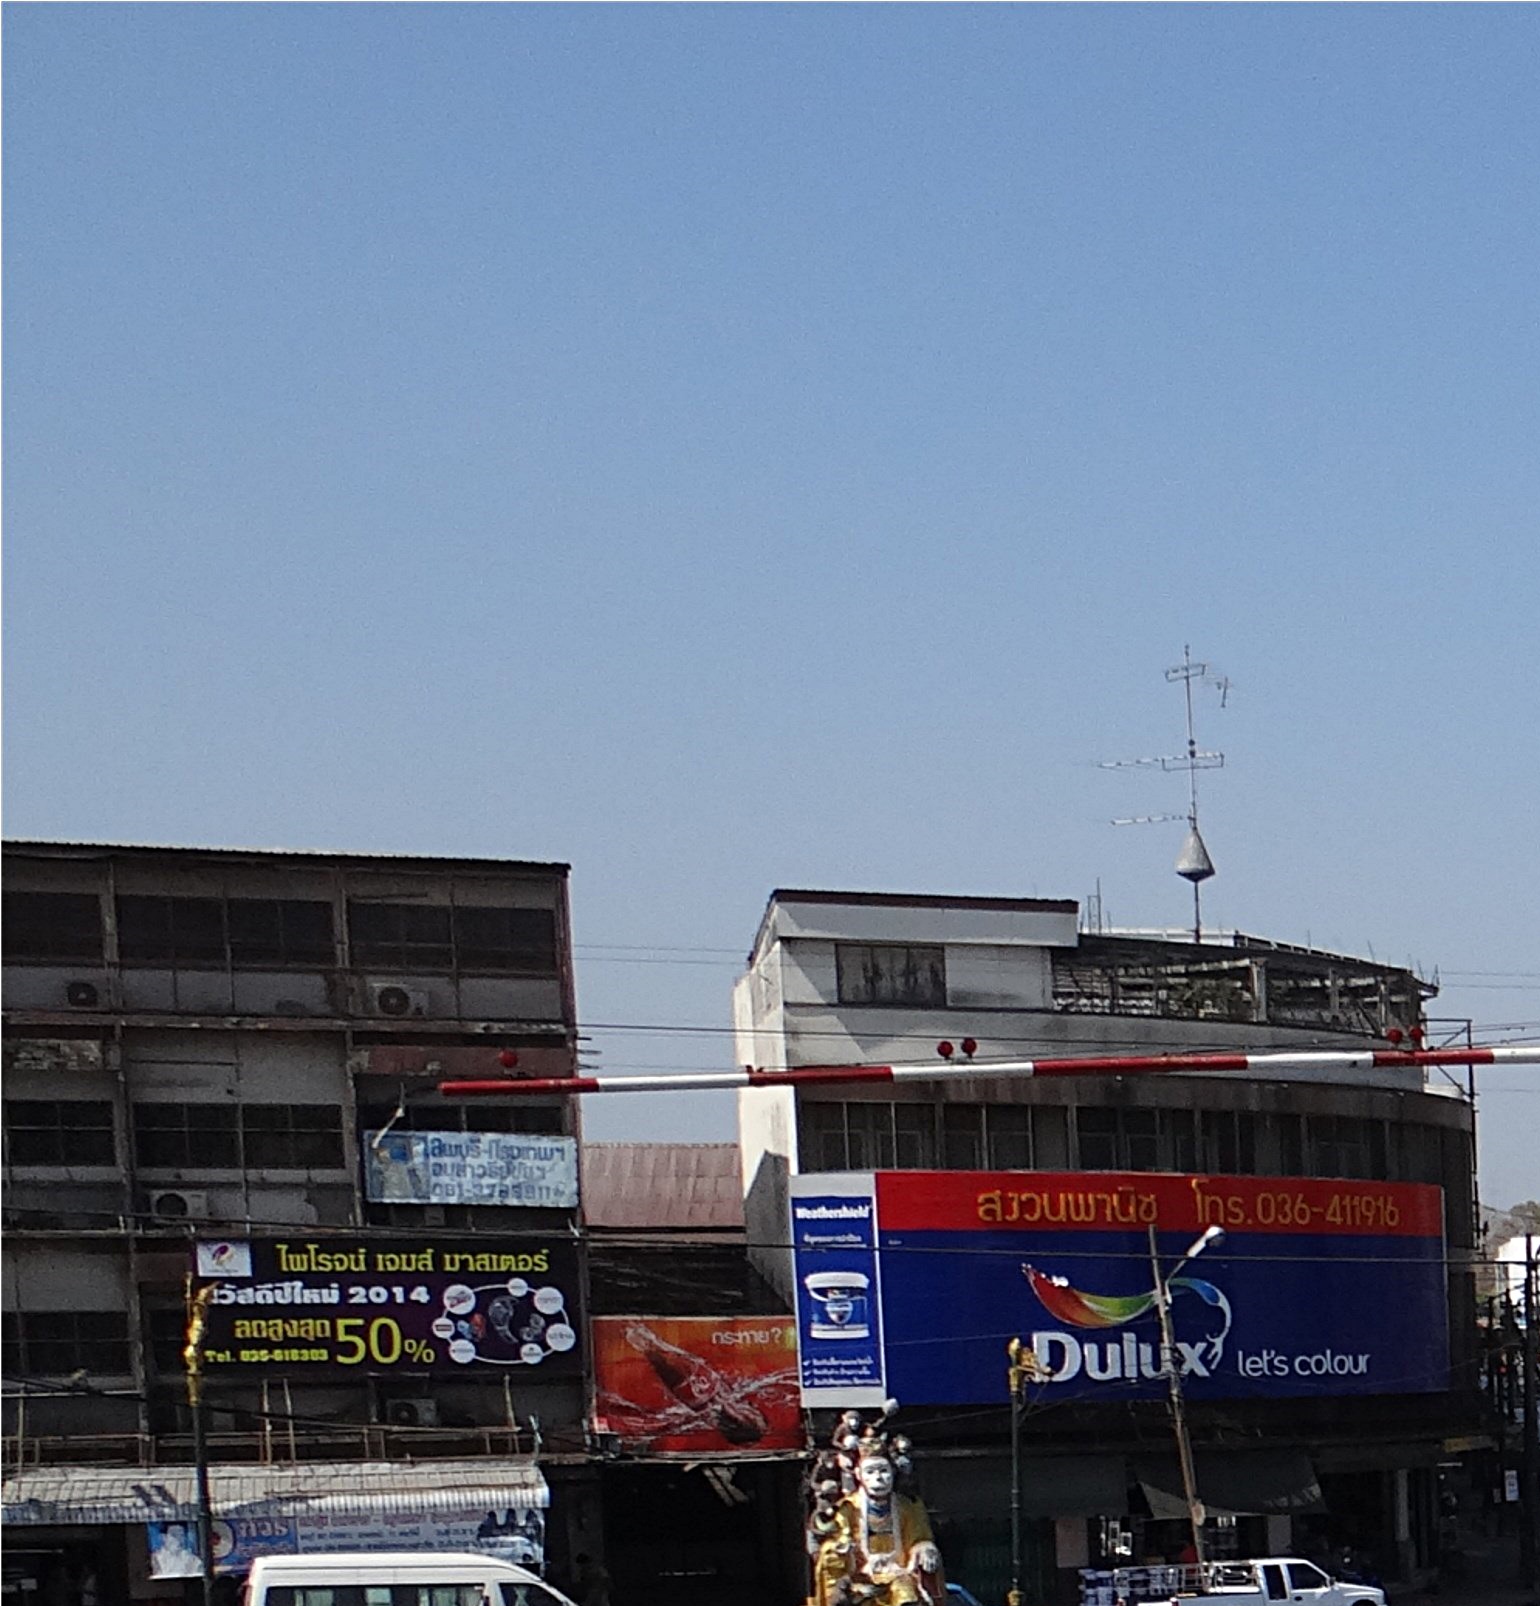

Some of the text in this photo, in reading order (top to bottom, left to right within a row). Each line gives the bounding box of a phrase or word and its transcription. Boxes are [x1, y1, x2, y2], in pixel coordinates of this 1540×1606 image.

[977, 1186, 1158, 1223] สงวนพานิช
[275, 1243, 550, 1272] ไพโรจน์ เจมส์ มาสเตอร์
[348, 1285, 431, 1304] 2014
[205, 1350, 236, 1362] Tel.
[234, 1316, 436, 1364] ลดสูงสุด 50%
[1032, 1331, 1370, 1382] Dulux let's colour
